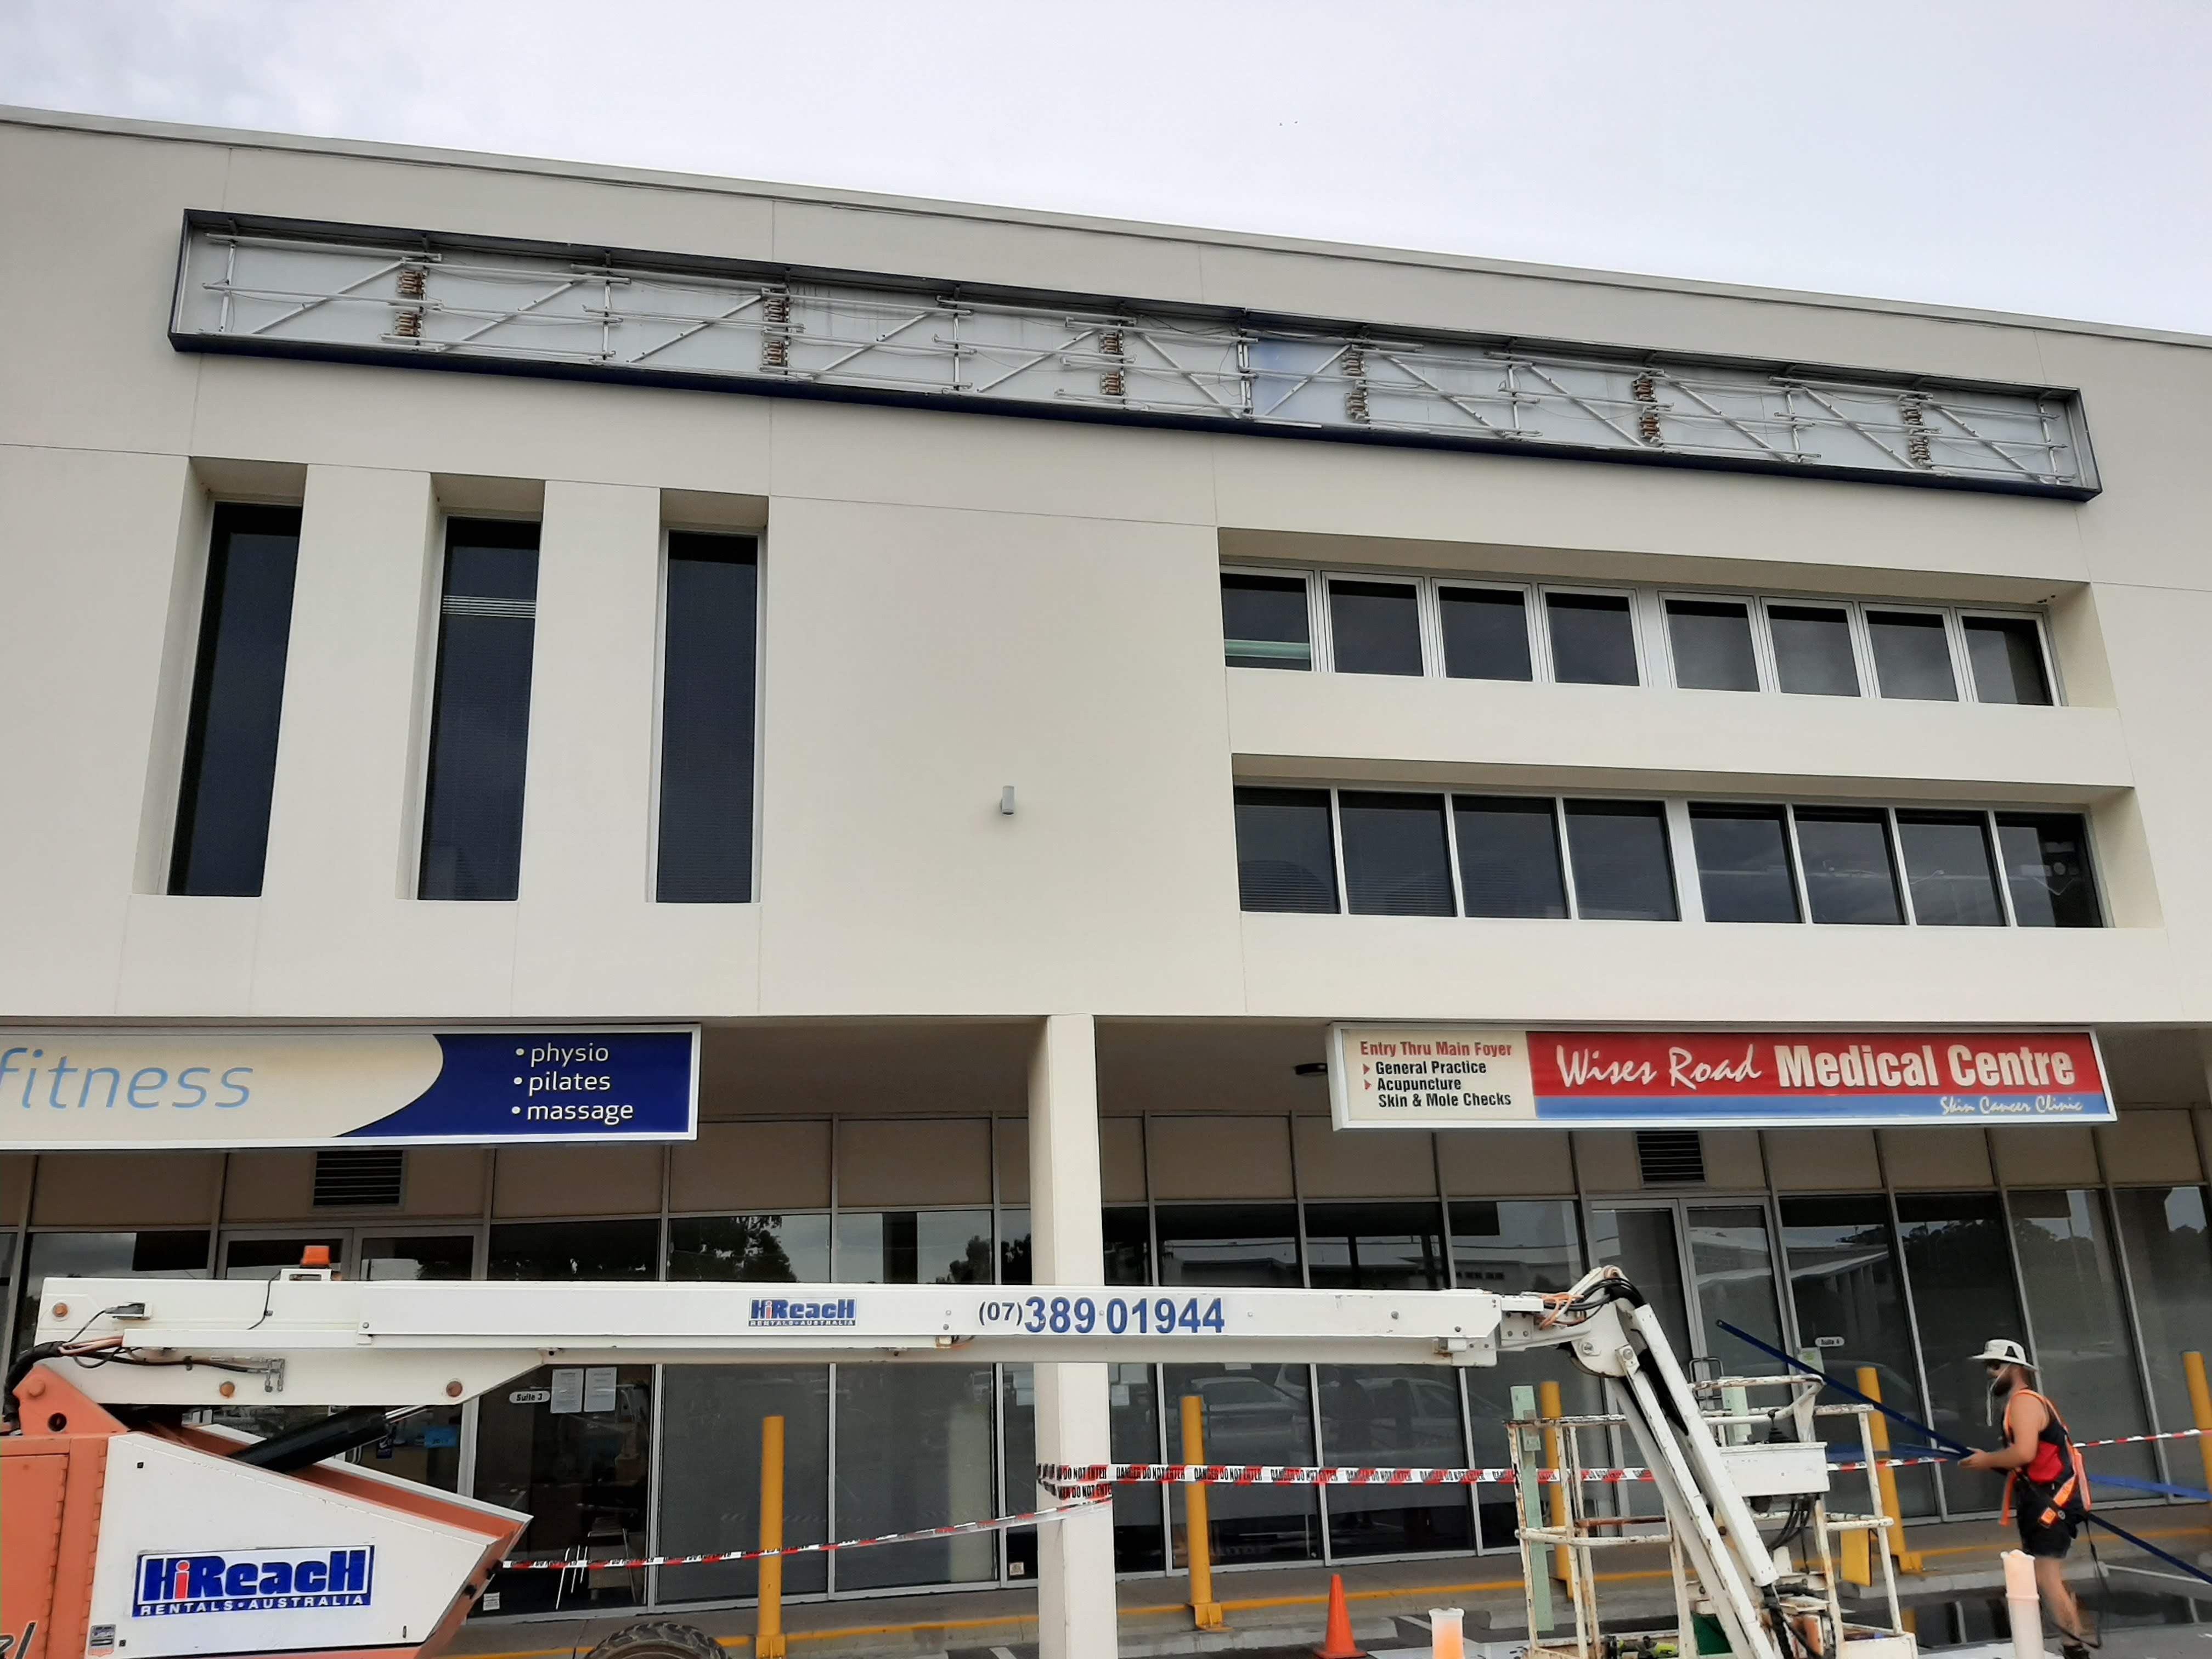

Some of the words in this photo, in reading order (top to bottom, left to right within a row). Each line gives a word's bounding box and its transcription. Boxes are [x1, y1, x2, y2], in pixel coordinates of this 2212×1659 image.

[531, 1042, 608, 1067] physio
[1361, 1041, 1396, 1057] Entry
[1400, 1041, 1431, 1056] Thru
[1436, 1042, 1470, 1056] Main
[1475, 1042, 1511, 1057] Foyer
[1376, 1061, 1427, 1074] General
[1431, 1060, 1486, 1074] Practice
[1556, 1045, 1657, 1087] Wises
[1668, 1043, 1762, 1090] Road
[1774, 1045, 1939, 1087] Medical
[1947, 1045, 2076, 1086] Centre
[0, 1047, 253, 1108] fitness
[529, 1071, 610, 1096] pilates
[1378, 1077, 1461, 1092] Acupuncture
[1379, 1094, 1407, 1107] Skin
[1413, 1093, 1422, 1107] &
[1426, 1093, 1458, 1106] Mole
[1463, 1092, 1511, 1106] Checks
[1940, 1096, 1975, 1115] Skin
[1979, 1096, 2031, 1114] Cancer
[2035, 1094, 2083, 1113] Clinic
[527, 1104, 634, 1125] massage
[1106, 1297, 1225, 1334] 01944
[516, 1393, 535, 1402] Suite
[1063, 1467, 1072, 1480] DO
[1073, 1466, 1086, 1480] NOT
[1143, 1467, 1151, 1479] DO
[1153, 1467, 1165, 1480] NOT
[1220, 1468, 1228, 1480] DO
[1230, 1468, 1242, 1481] NOT
[1072, 1486, 1081, 1498] DO
[1082, 1485, 1094, 1498] NOT
[1096, 1483, 1112, 1497] ENTE
[140, 1601, 233, 1616] RENTALS
[249, 1595, 364, 1610] AUSTRALIA
